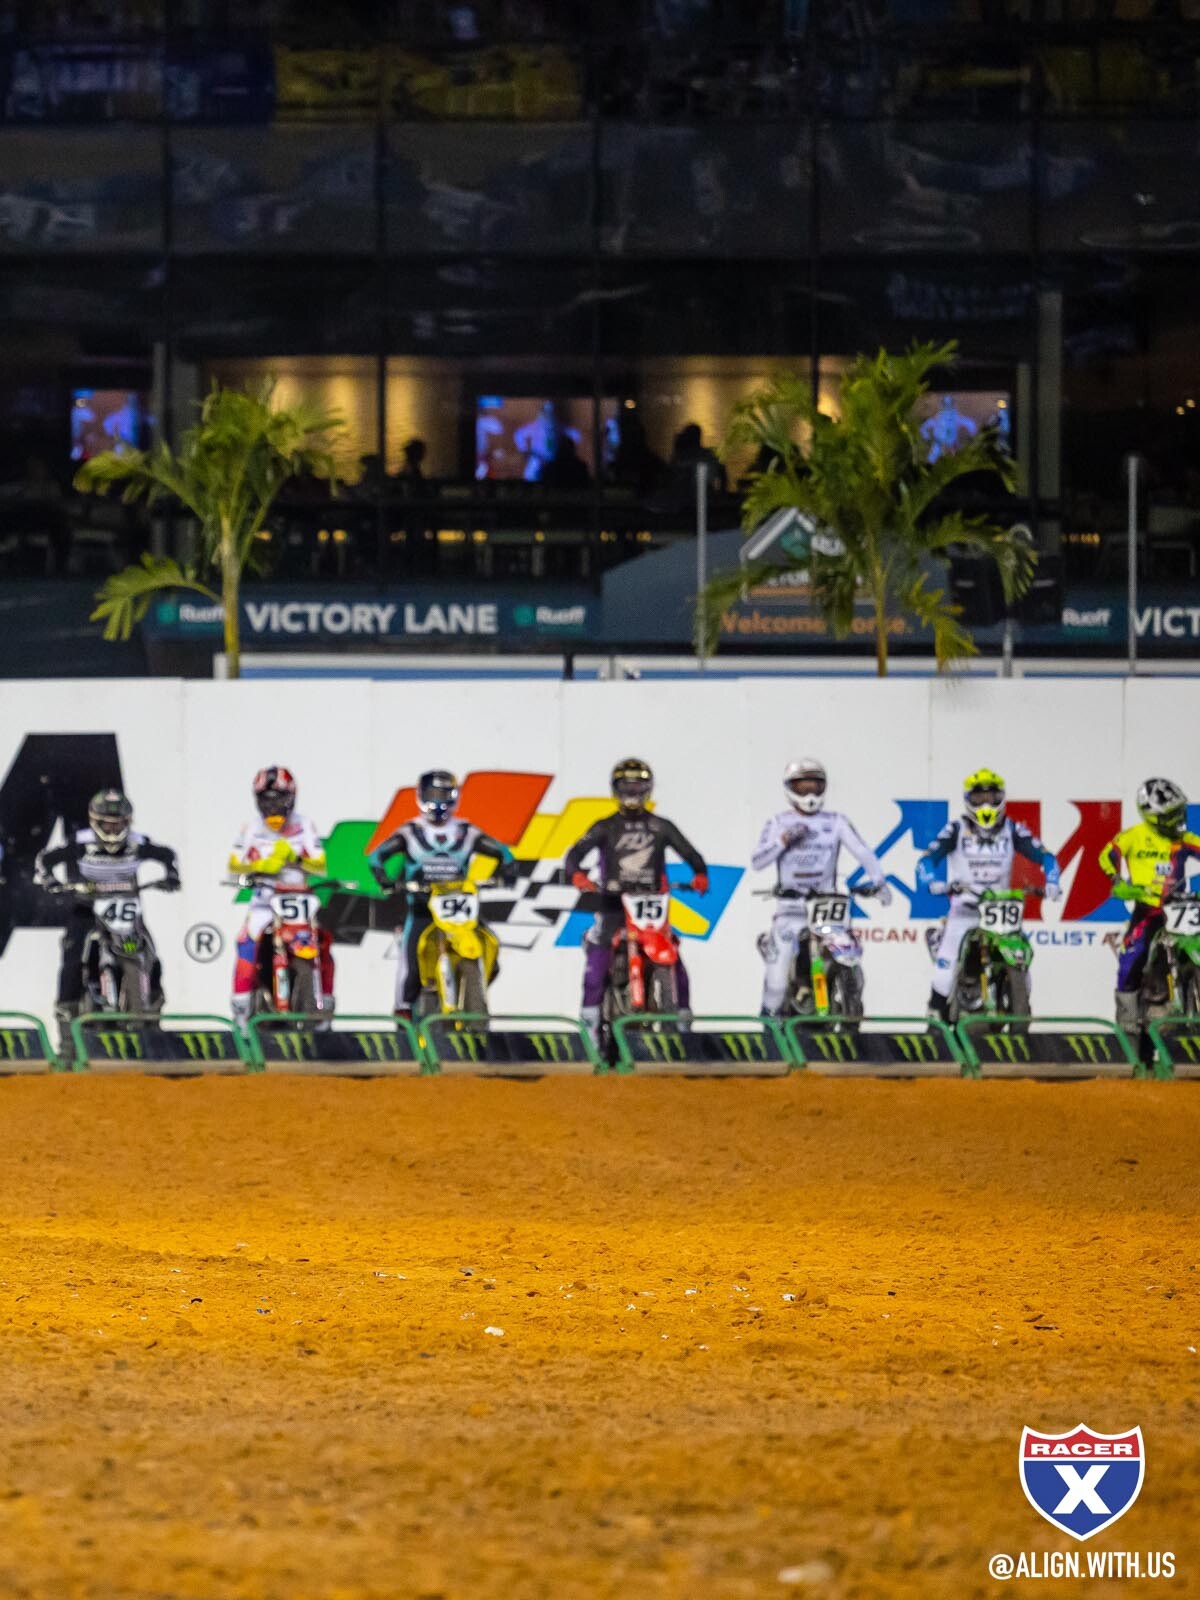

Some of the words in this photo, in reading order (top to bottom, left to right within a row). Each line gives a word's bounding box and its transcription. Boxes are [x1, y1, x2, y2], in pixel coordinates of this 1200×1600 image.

[245, 602, 398, 634] VICTORY
[404, 603, 499, 635] LANE
[104, 903, 137, 921] 46
[281, 898, 309, 920] 51
[442, 898, 471, 918] 94
[636, 901, 662, 919] 15
[812, 902, 848, 923] 68
[985, 904, 1019, 926] 519
[851, 927, 918, 943] RICAN
